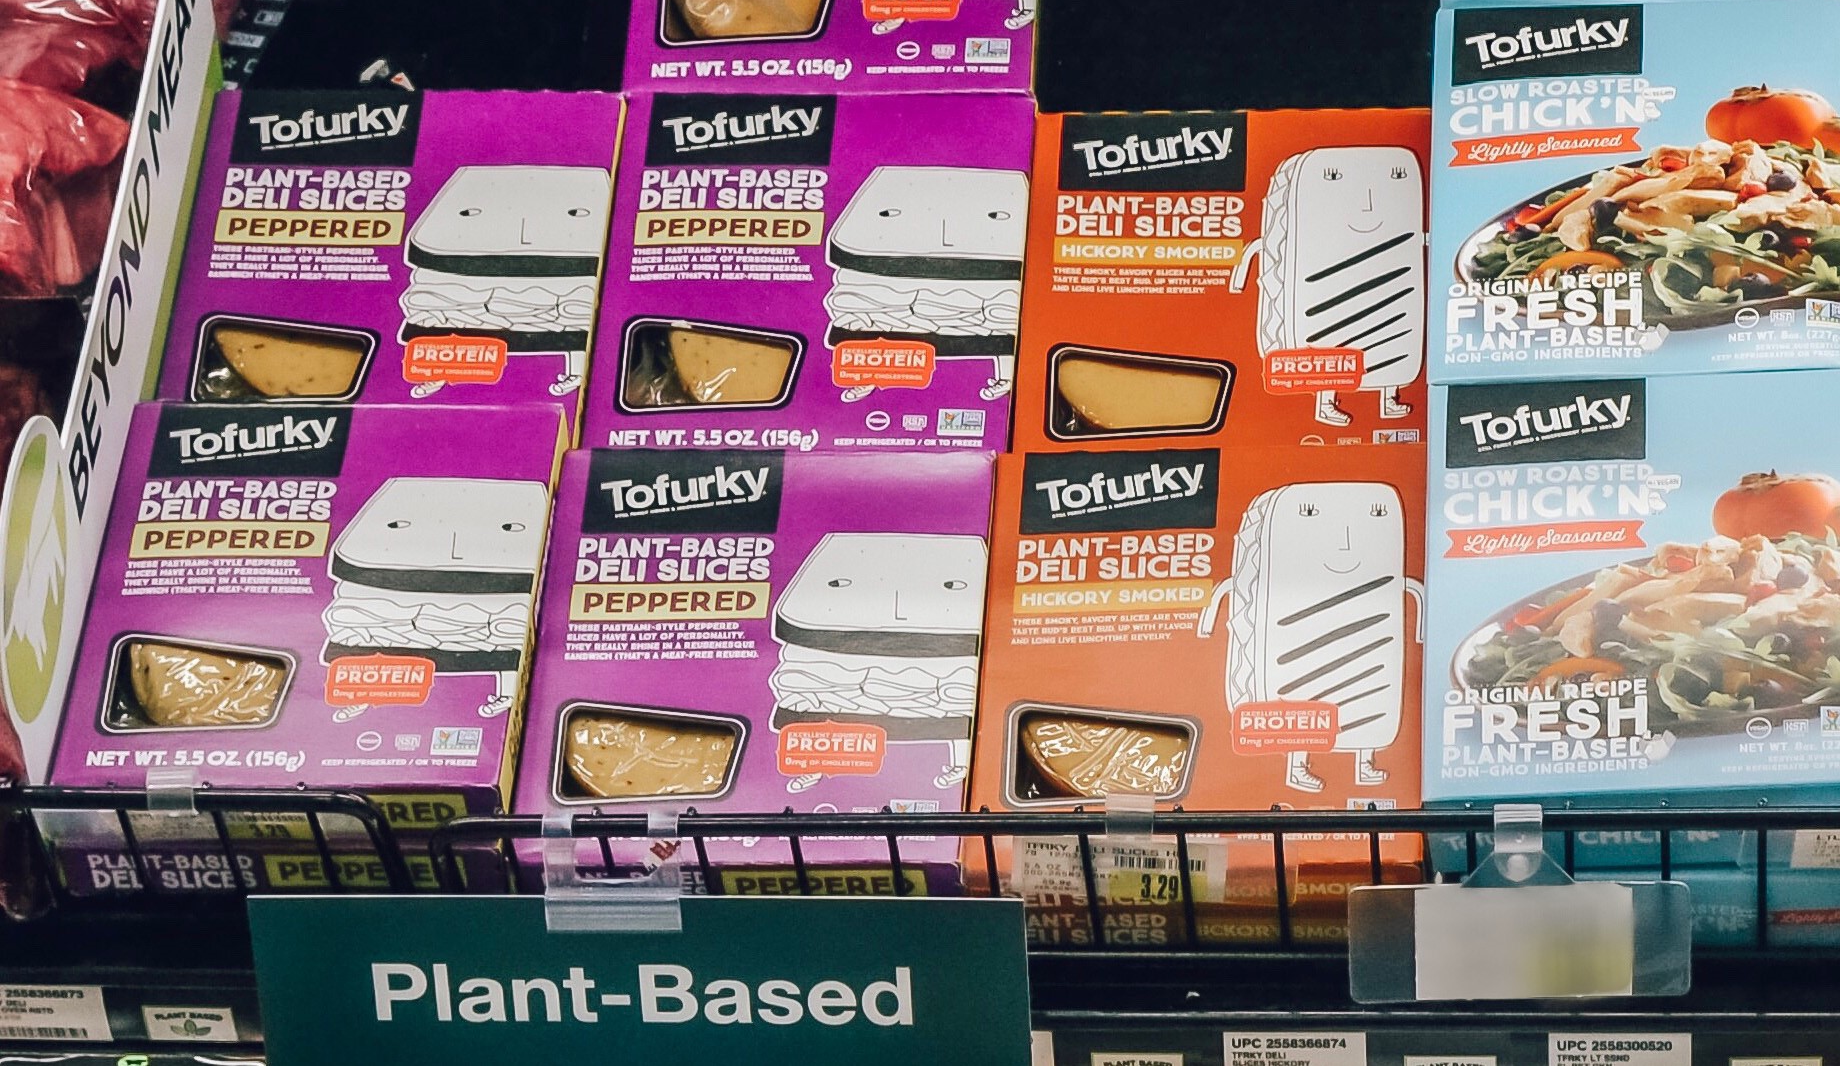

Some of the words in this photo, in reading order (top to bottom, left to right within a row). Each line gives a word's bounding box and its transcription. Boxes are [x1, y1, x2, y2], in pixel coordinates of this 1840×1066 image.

[1465, 17, 1629, 63] Tofurky
[651, 62, 693, 77] NET
[695, 61, 727, 77] WT.
[731, 61, 762, 77] 5.5
[797, 59, 852, 80] (156g)
[1450, 84, 1523, 105] SLOW
[1528, 80, 1650, 98] ROASTED
[250, 104, 409, 144] Tofurky
[663, 105, 822, 146] Tofurky
[1449, 96, 1647, 137] CHICK'N
[1074, 127, 1233, 172] Tofurky
[1468, 141, 1535, 161] Lightly
[1538, 134, 1623, 154] Seasoned
[226, 168, 412, 190] PLANT-BASED
[642, 169, 828, 189] PLANT-BASED
[221, 188, 290, 210] DELI
[298, 190, 406, 210] SLICES
[1057, 196, 1245, 216] PLANT-BASED
[228, 218, 392, 238] PEPPERED
[1061, 244, 1148, 260] HICKORY
[1154, 245, 1236, 260] SMOKED
[69, 158, 150, 523] BEYOND
[412, 347, 499, 364] PROTEIN
[1271, 359, 1357, 373] PROTEIN
[1460, 395, 1631, 447] Tofurky
[169, 416, 334, 459] Tofurky
[142, 480, 338, 501] PLANT-BASED
[600, 465, 769, 511] Tofurky
[1035, 463, 1204, 513] Tofurky
[138, 499, 211, 521] DELI
[218, 500, 331, 521] SLICES
[143, 530, 316, 550] PEPPERED
[579, 538, 775, 558] PLANT-BASED
[1018, 534, 1216, 560] PLANT-BASED
[1016, 558, 1086, 583] DELI
[1098, 555, 1212, 579] SLICES
[1021, 590, 1113, 607] HICKORY
[1119, 587, 1205, 603] SMOKED
[1444, 685, 1555, 706] ORIGINAL
[1562, 678, 1648, 699] RECIPE
[1441, 696, 1650, 745] FRESH
[1441, 764, 1530, 779] NON-GMO
[1534, 758, 1649, 776] INGREDIENTS
[1141, 874, 1179, 901] 3.29
[371, 963, 914, 1027] Plant-Based
[1231, 1038, 1261, 1049] UPC
[1557, 1040, 1586, 1051] UPC
[1591, 1041, 1672, 1051] 2558300520
